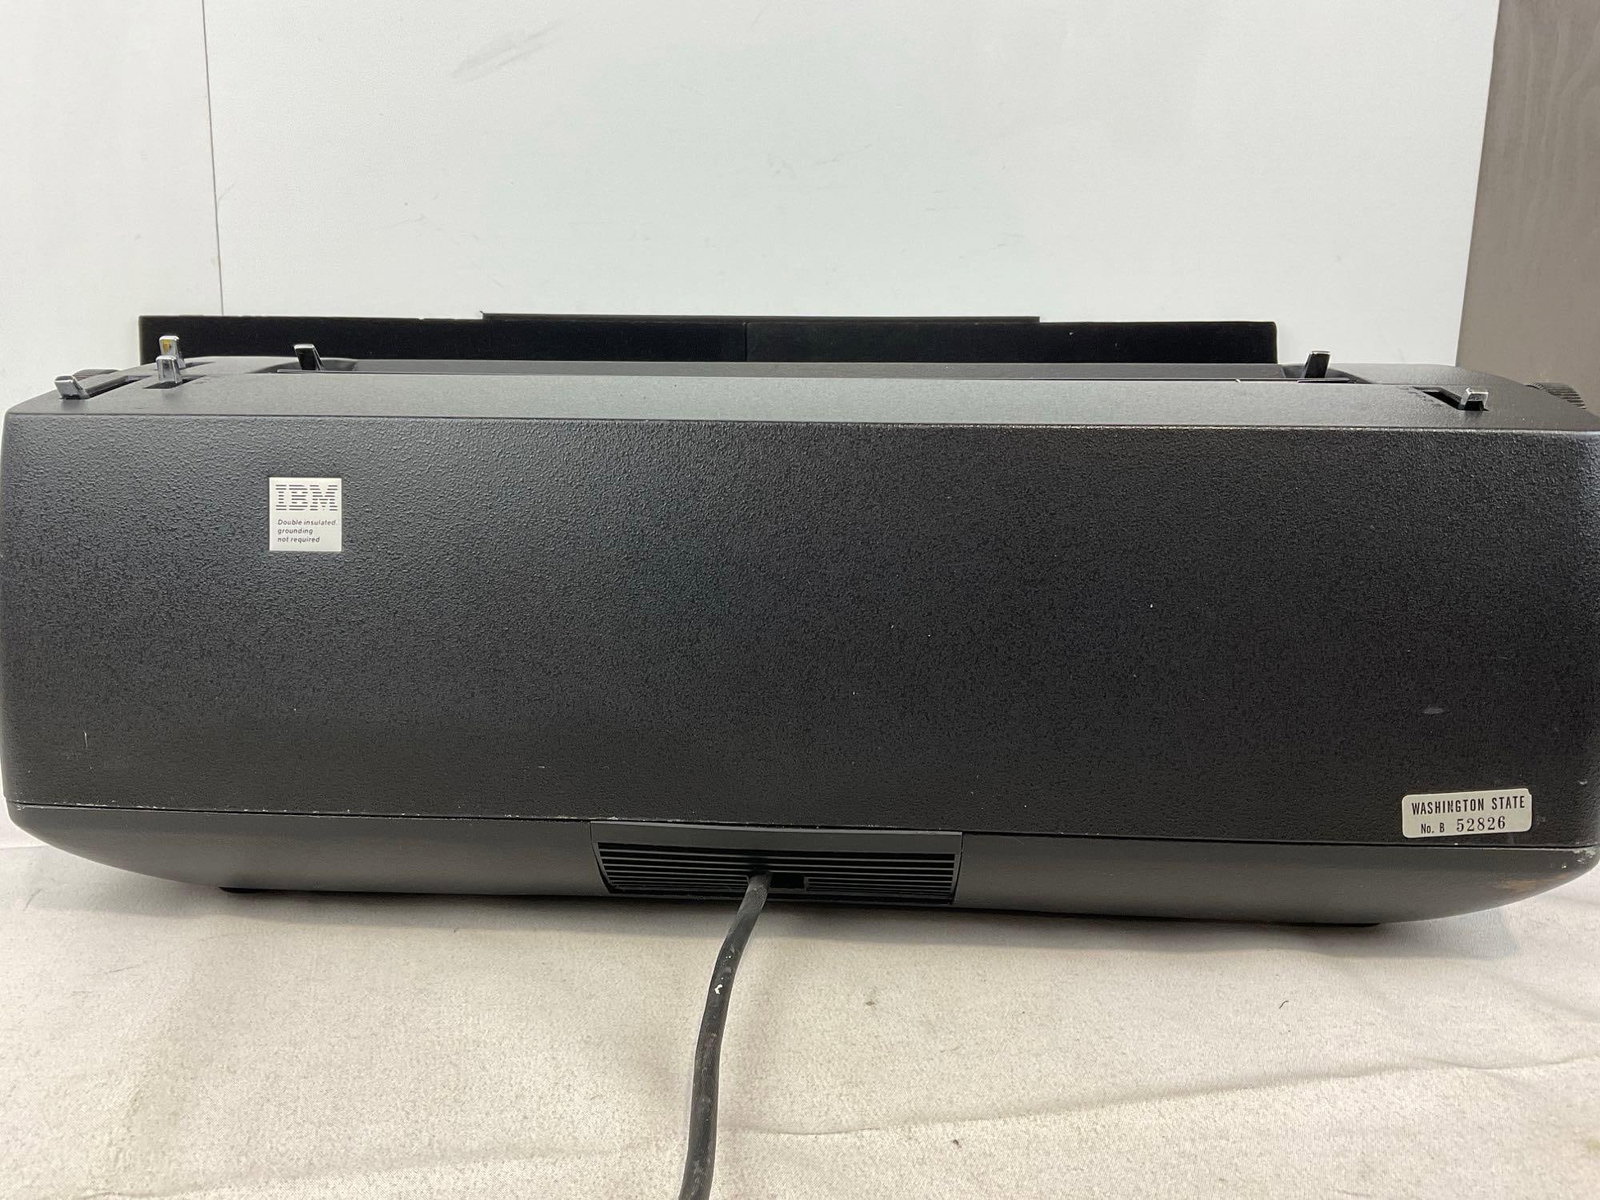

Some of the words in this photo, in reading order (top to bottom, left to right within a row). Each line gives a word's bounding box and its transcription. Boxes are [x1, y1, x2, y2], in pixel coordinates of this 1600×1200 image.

[275, 484, 338, 511] IBM
[290, 536, 320, 544] required
[1411, 798, 1484, 815] WASHINGTON
[1491, 795, 1525, 810] STATE
[1420, 823, 1434, 834] No.
[1439, 822, 1445, 833] B
[1456, 815, 1506, 833] 52826
